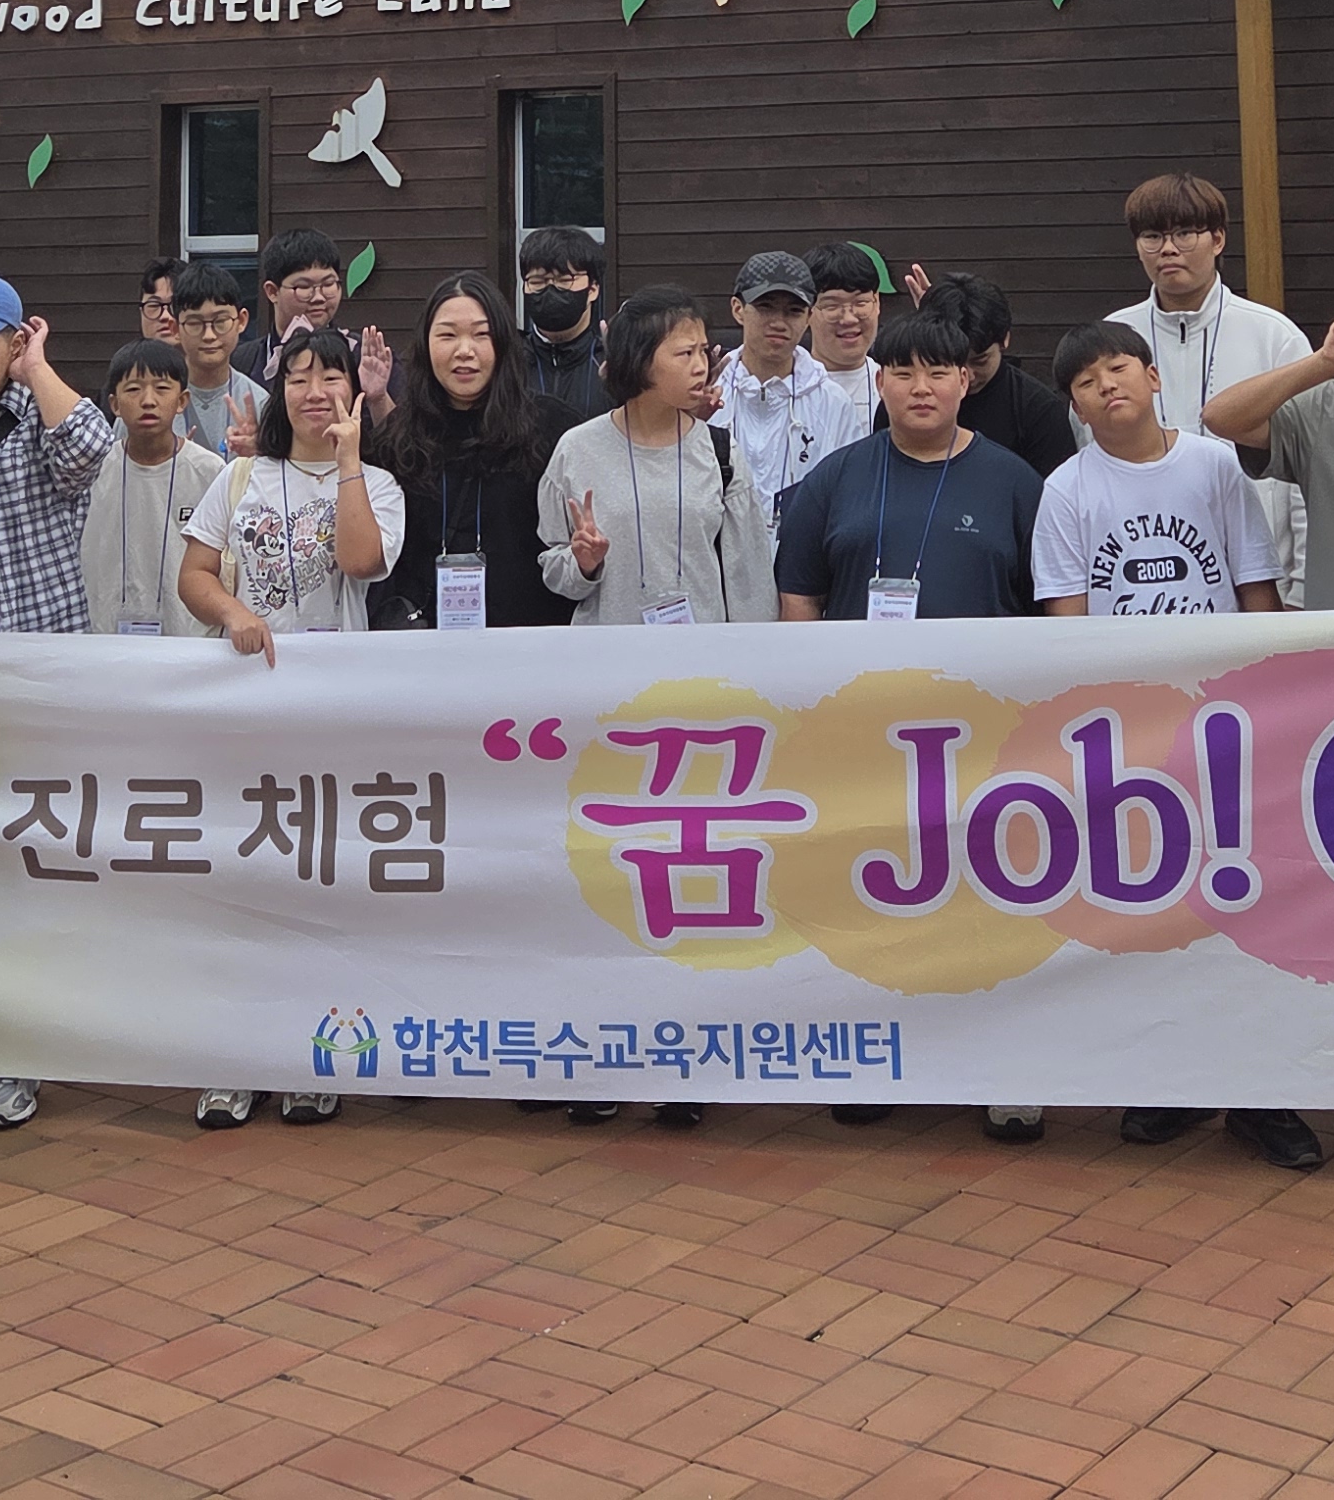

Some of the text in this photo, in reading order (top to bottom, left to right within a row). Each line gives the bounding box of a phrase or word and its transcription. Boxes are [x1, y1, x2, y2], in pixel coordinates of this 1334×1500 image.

[1091, 532, 1123, 592] NEW
[1124, 513, 1222, 586] STANDARD
[1137, 559, 1175, 581] 2008
[3, 772, 215, 884] 진로
[237, 771, 449, 894] 체험
[862, 704, 1259, 908] Job!
[393, 1014, 904, 1082] 합천특수교육지원센터
